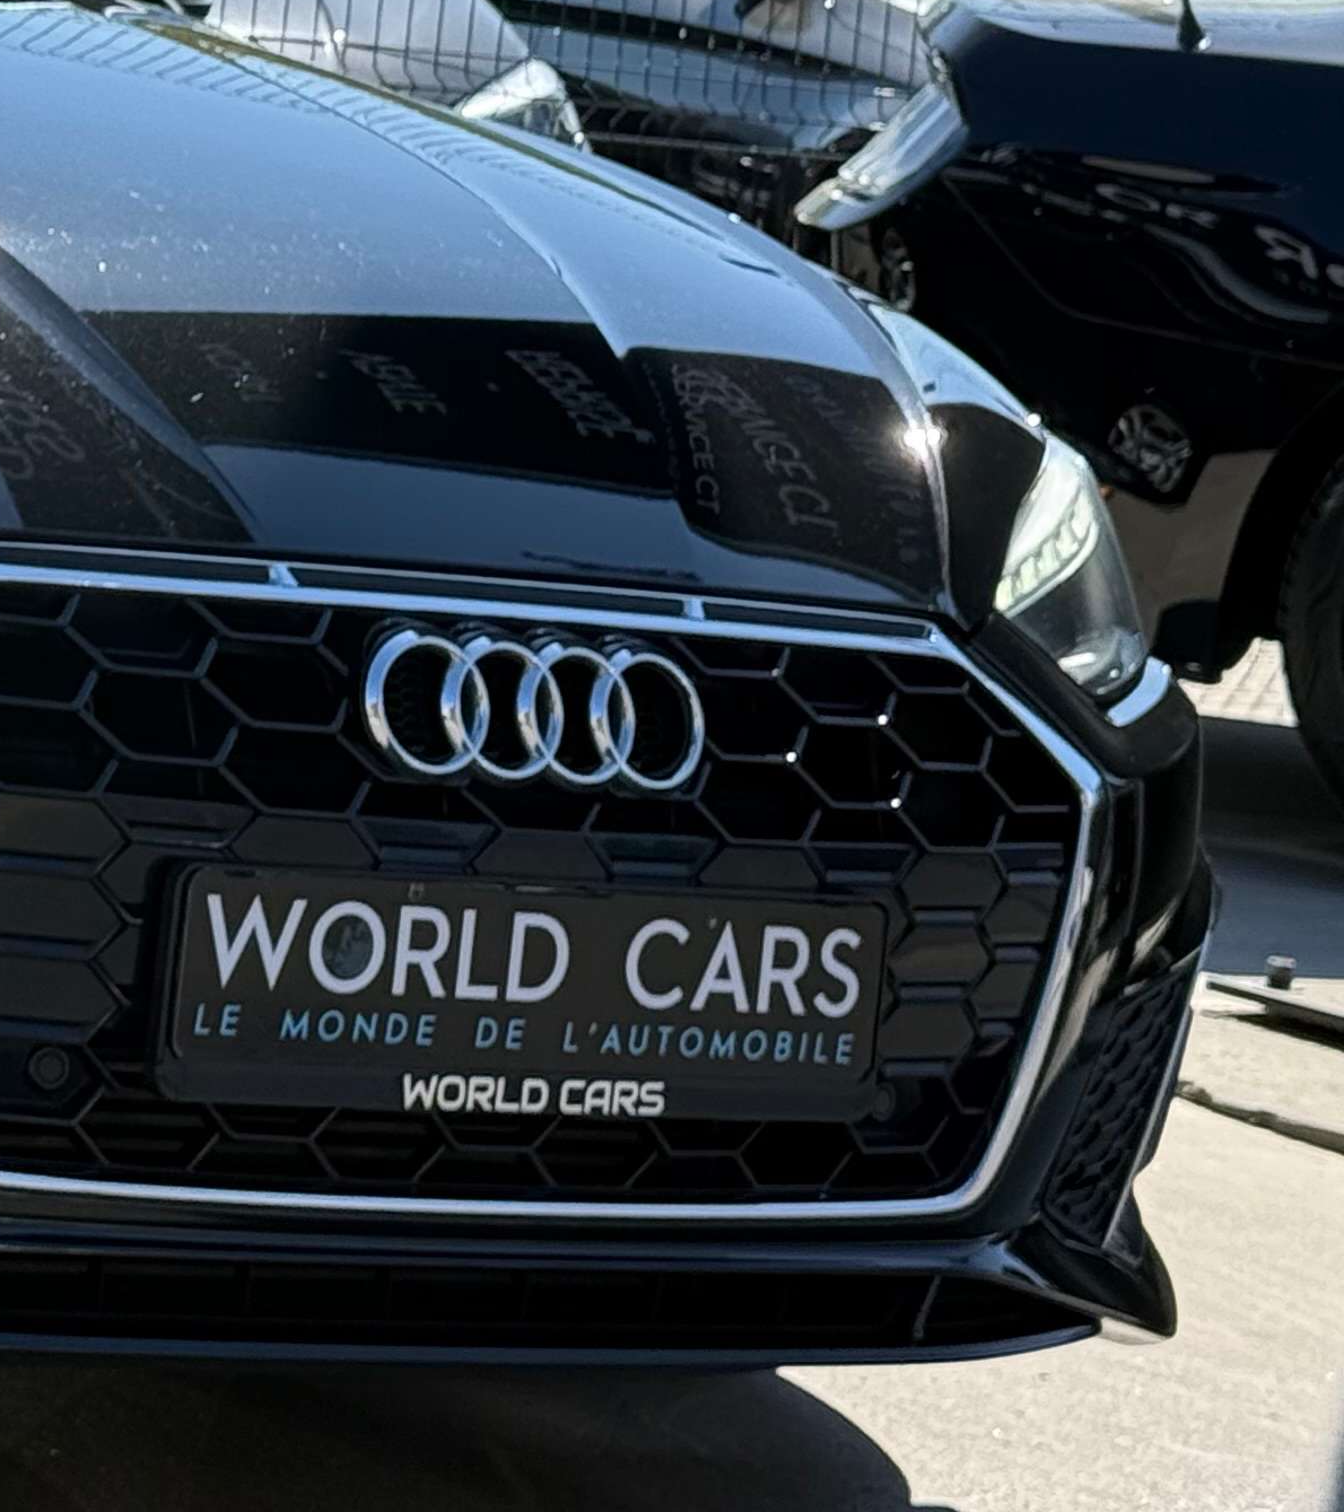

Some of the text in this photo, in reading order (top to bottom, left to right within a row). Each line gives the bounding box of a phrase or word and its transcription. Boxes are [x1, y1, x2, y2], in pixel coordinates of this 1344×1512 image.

[207, 893, 861, 1019] WORLD CARS
[193, 1003, 854, 1065] LE MONDE DE L'AUTOMOBILE
[402, 1073, 666, 1117] WORLD CARS
